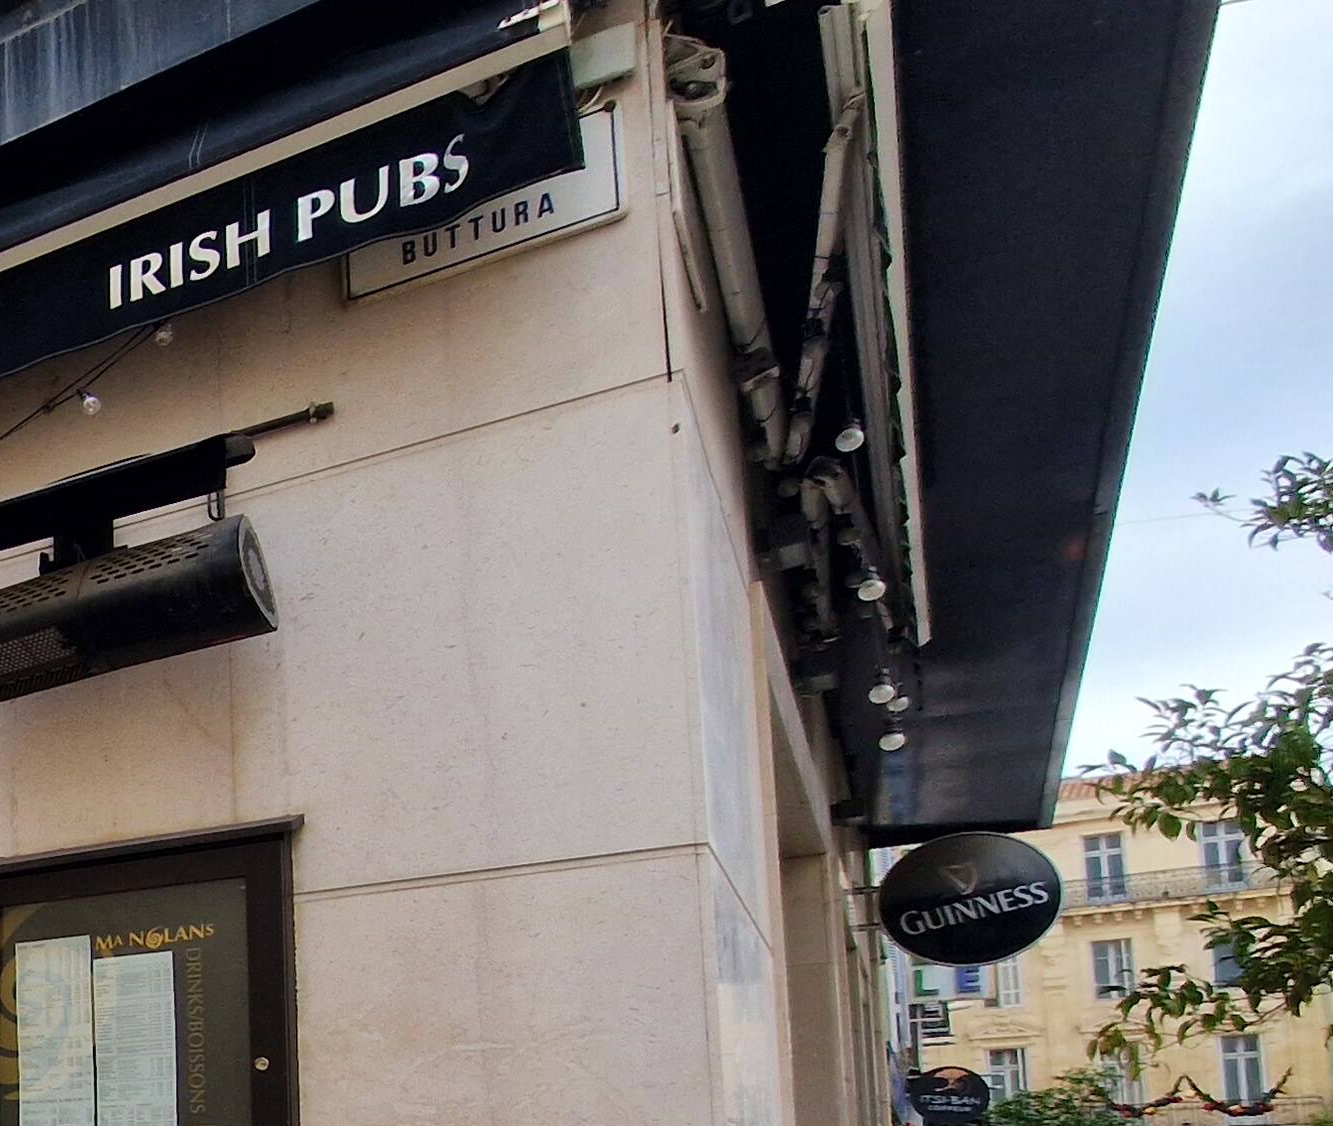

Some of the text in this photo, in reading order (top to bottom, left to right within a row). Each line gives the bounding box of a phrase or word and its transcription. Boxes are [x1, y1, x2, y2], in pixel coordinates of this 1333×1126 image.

[109, 134, 469, 309] IRISH PUBS
[402, 191, 555, 266] BUTTURA
[96, 934, 123, 950] MA
[900, 881, 1050, 936] GUINNESS
[186, 947, 206, 1114] DRINKS/BOISSONS
